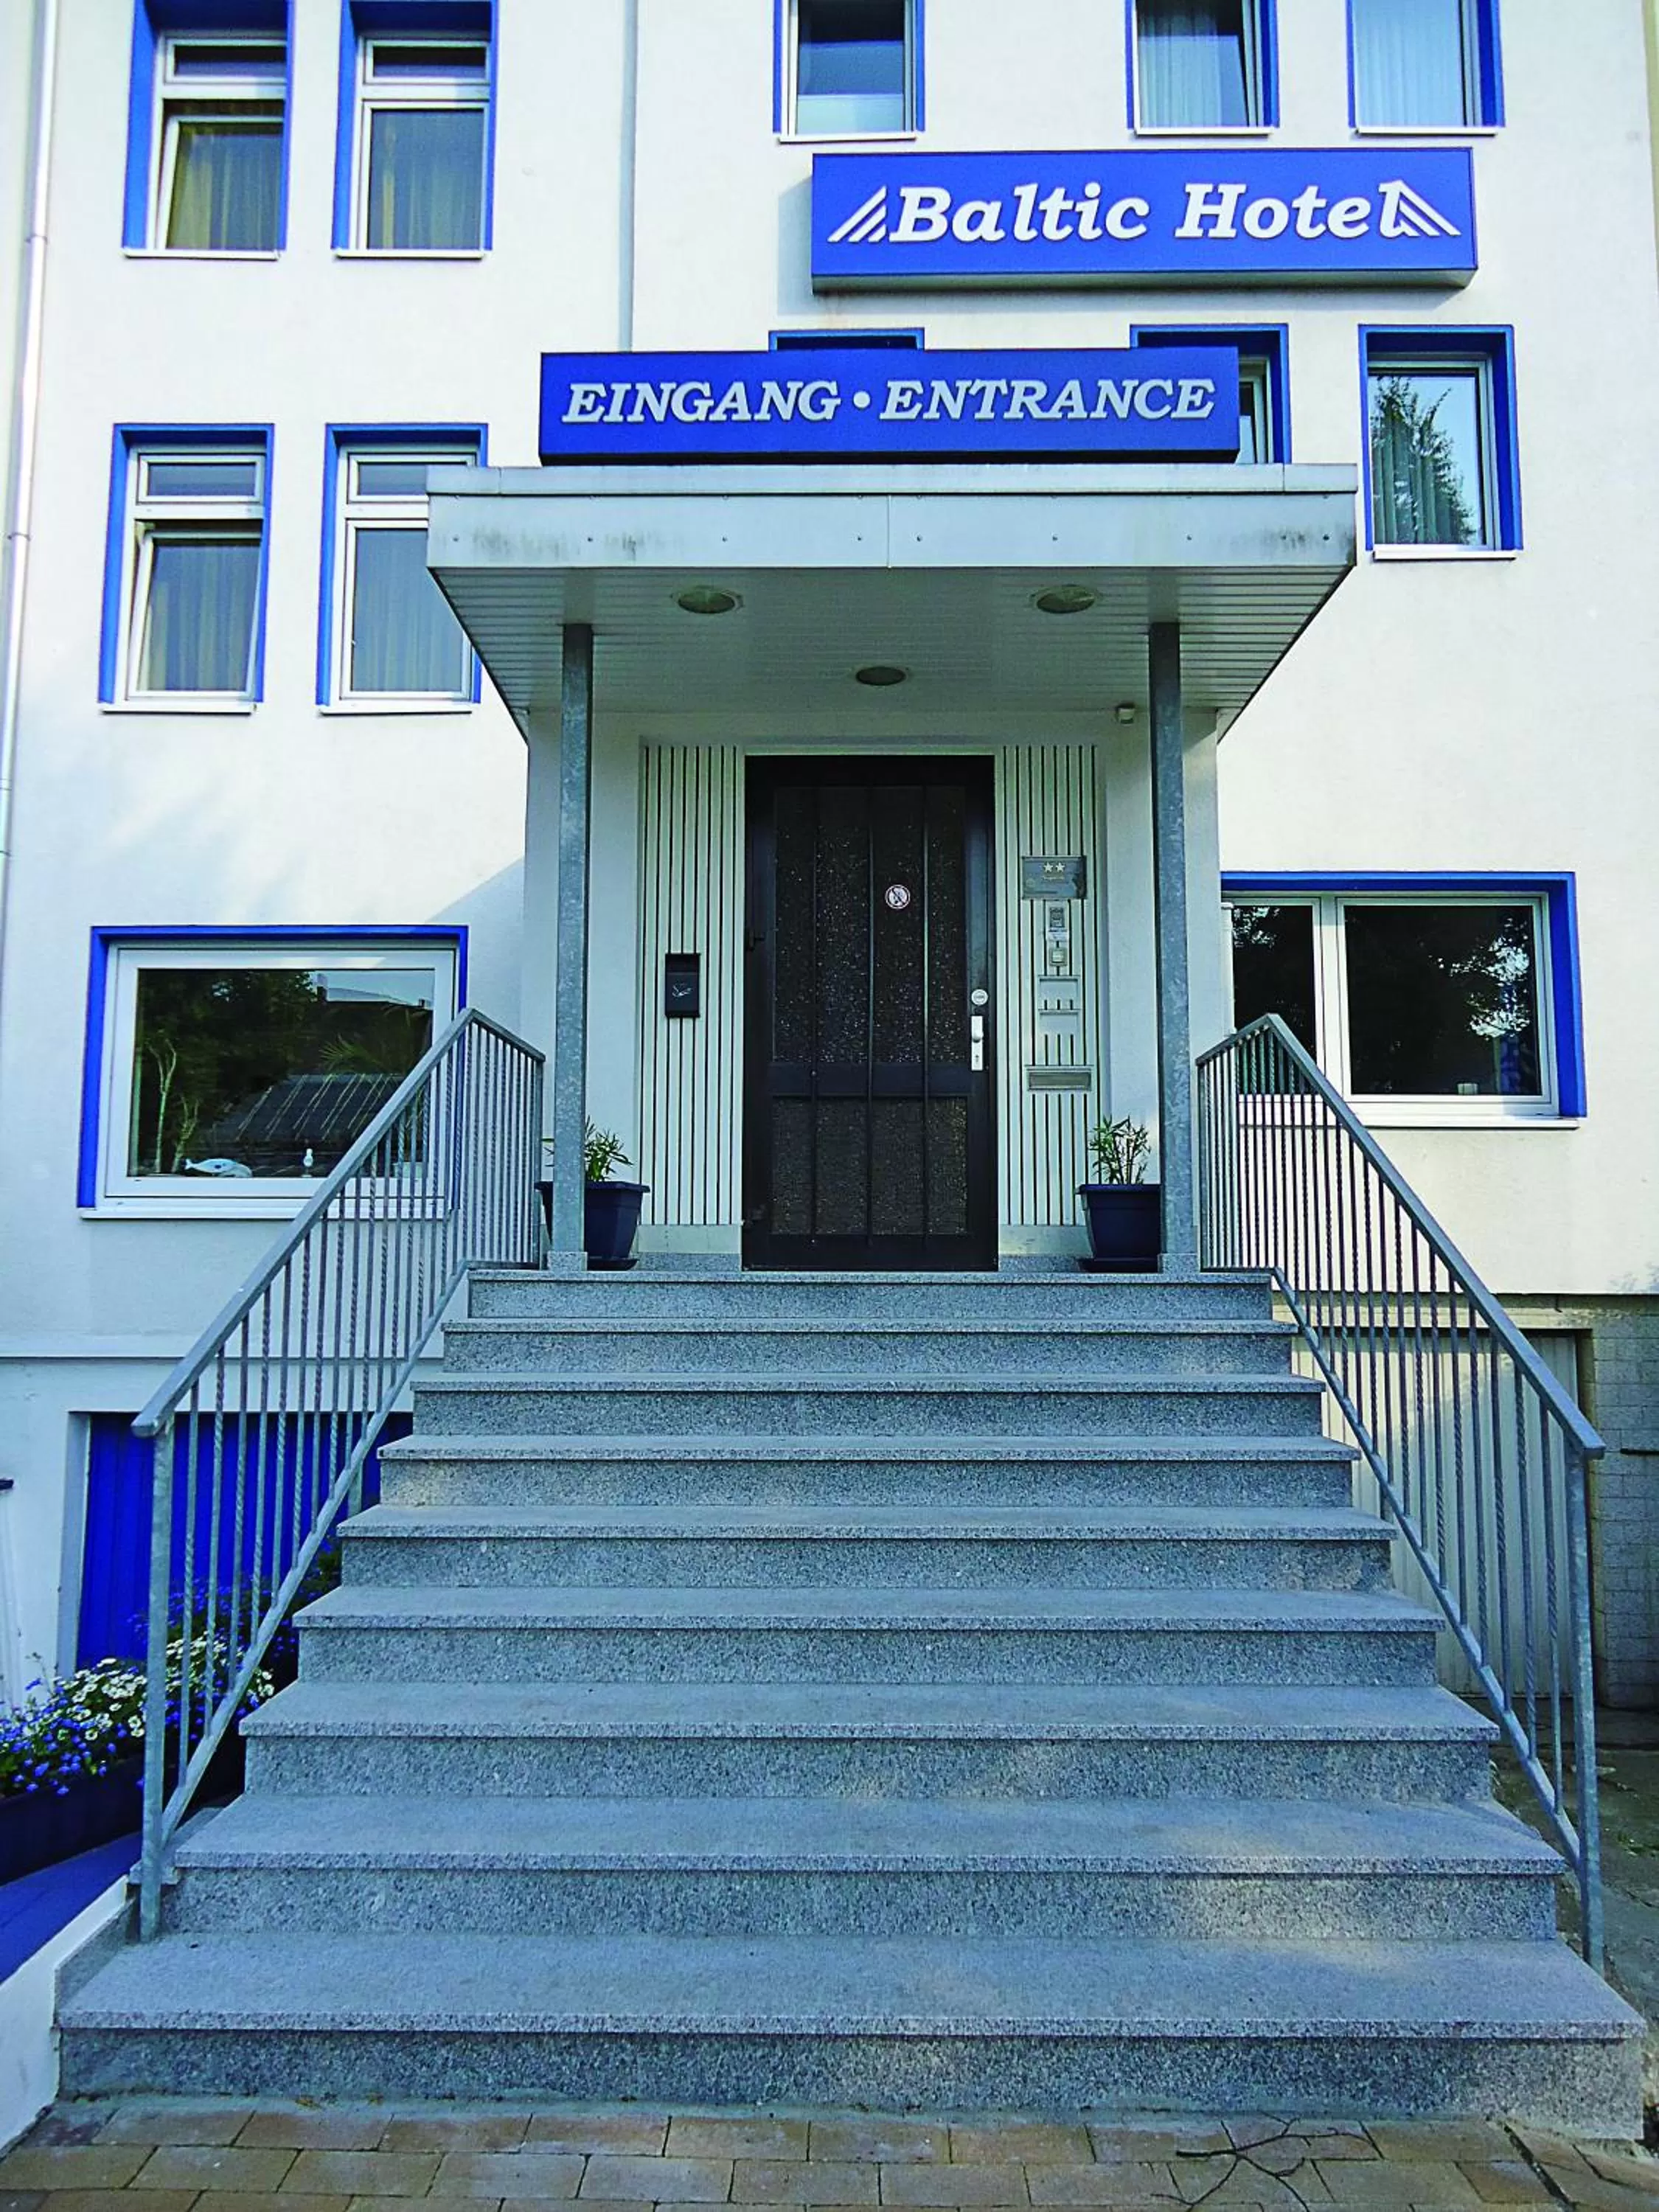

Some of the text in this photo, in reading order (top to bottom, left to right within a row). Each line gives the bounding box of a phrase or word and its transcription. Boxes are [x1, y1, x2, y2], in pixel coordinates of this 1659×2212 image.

[888, 179, 1412, 243] Baltic Hotel
[561, 378, 1216, 423] EINGANG ENTRANCE
